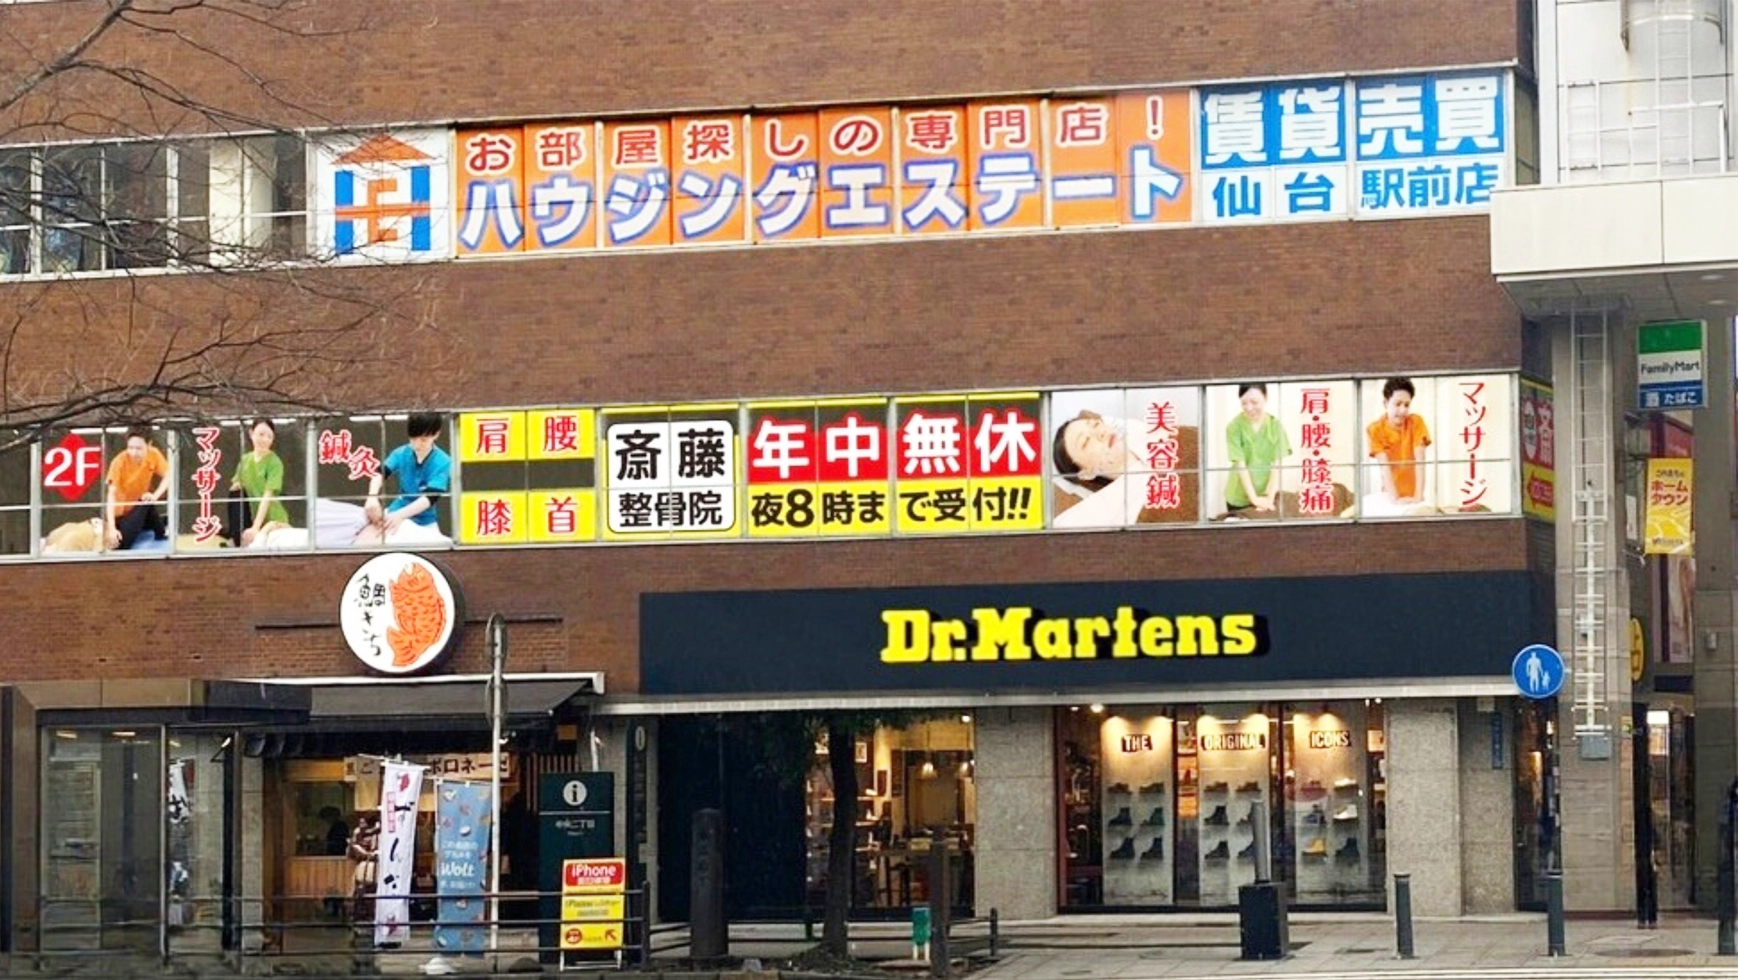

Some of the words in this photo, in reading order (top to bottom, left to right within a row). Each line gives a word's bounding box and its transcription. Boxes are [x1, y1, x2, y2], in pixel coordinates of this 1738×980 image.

[1204, 78, 1499, 164] 賃貸売買
[459, 145, 1183, 250] ハウジングエステート
[1641, 361, 1700, 374] FamilyMart
[319, 430, 379, 480] 鍼灸
[615, 428, 726, 480] 斎藤
[753, 412, 1037, 479] 年中無休
[1145, 401, 1180, 509] 美容鍼
[1458, 381, 1488, 508] マッサージ
[43, 446, 101, 488] 2F
[192, 426, 221, 543] マッサージ
[1651, 480, 1689, 493] ホーム
[618, 490, 722, 528] 整骨院
[751, 487, 1031, 529] 夜8時まで受付!!
[1651, 493, 1688, 506] タウン
[1124, 735, 1150, 751] THE
[1204, 734, 1264, 750] ORIGINAL
[1311, 732, 1350, 747] ICONS
[441, 861, 476, 878] Wolt
[571, 864, 617, 878] iPhone
